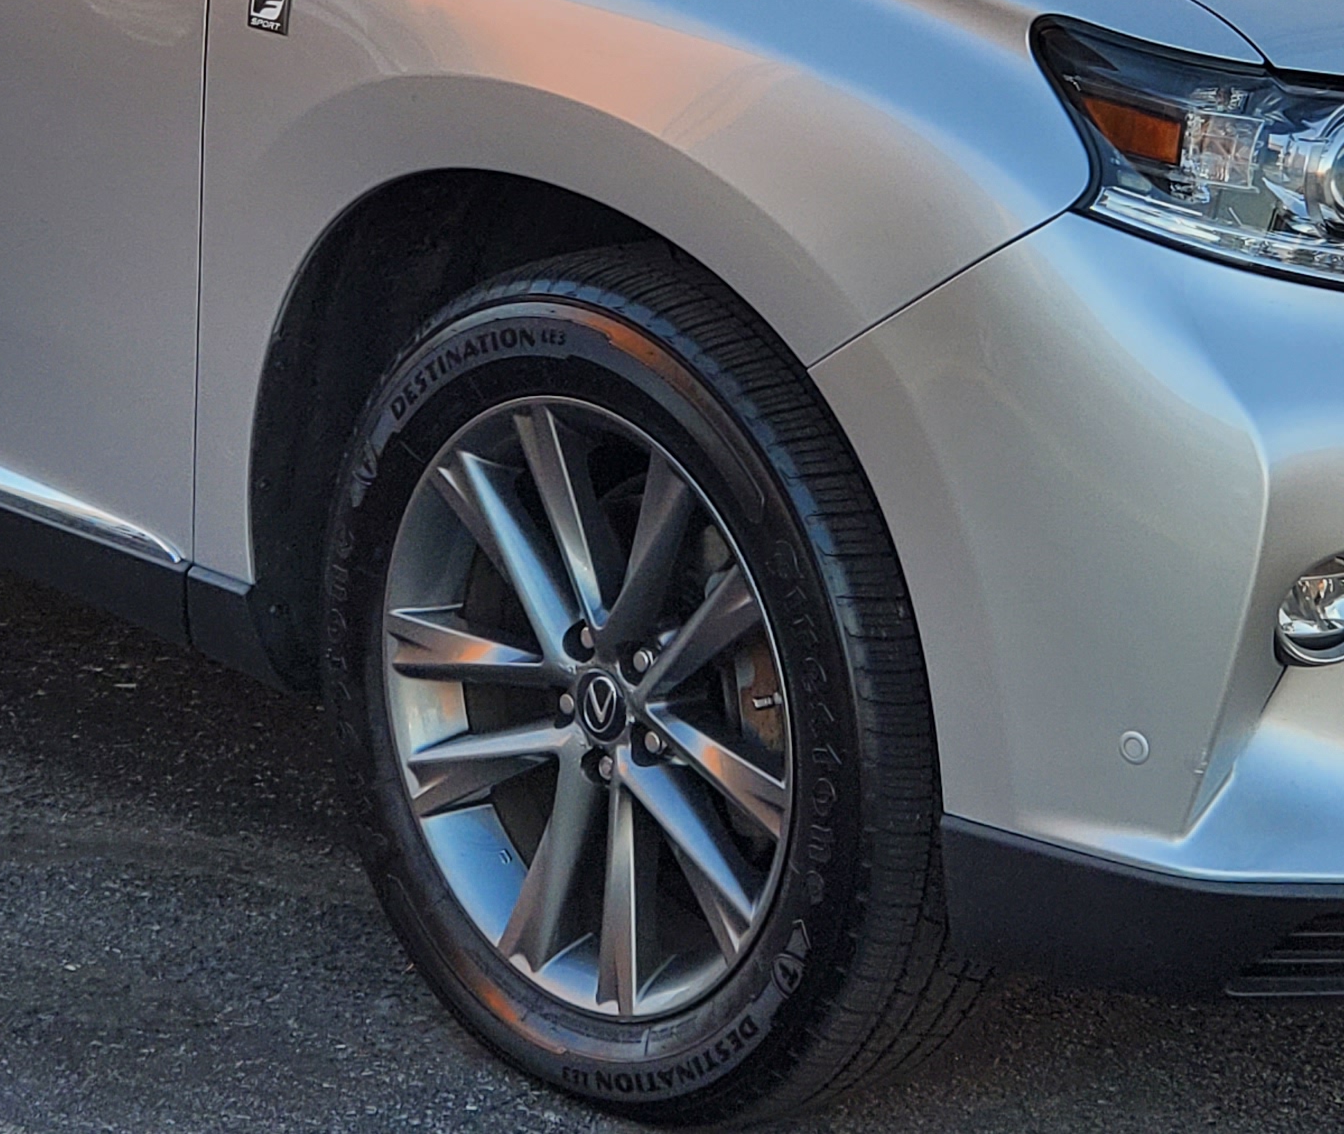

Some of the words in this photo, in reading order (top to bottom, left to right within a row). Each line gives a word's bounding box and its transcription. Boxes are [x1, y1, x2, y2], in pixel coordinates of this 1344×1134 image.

[250, 17, 281, 30] SPORT
[390, 327, 537, 421] DESTINATION
[541, 329, 567, 347] LE3
[596, 1015, 759, 1094] DESTINATION
